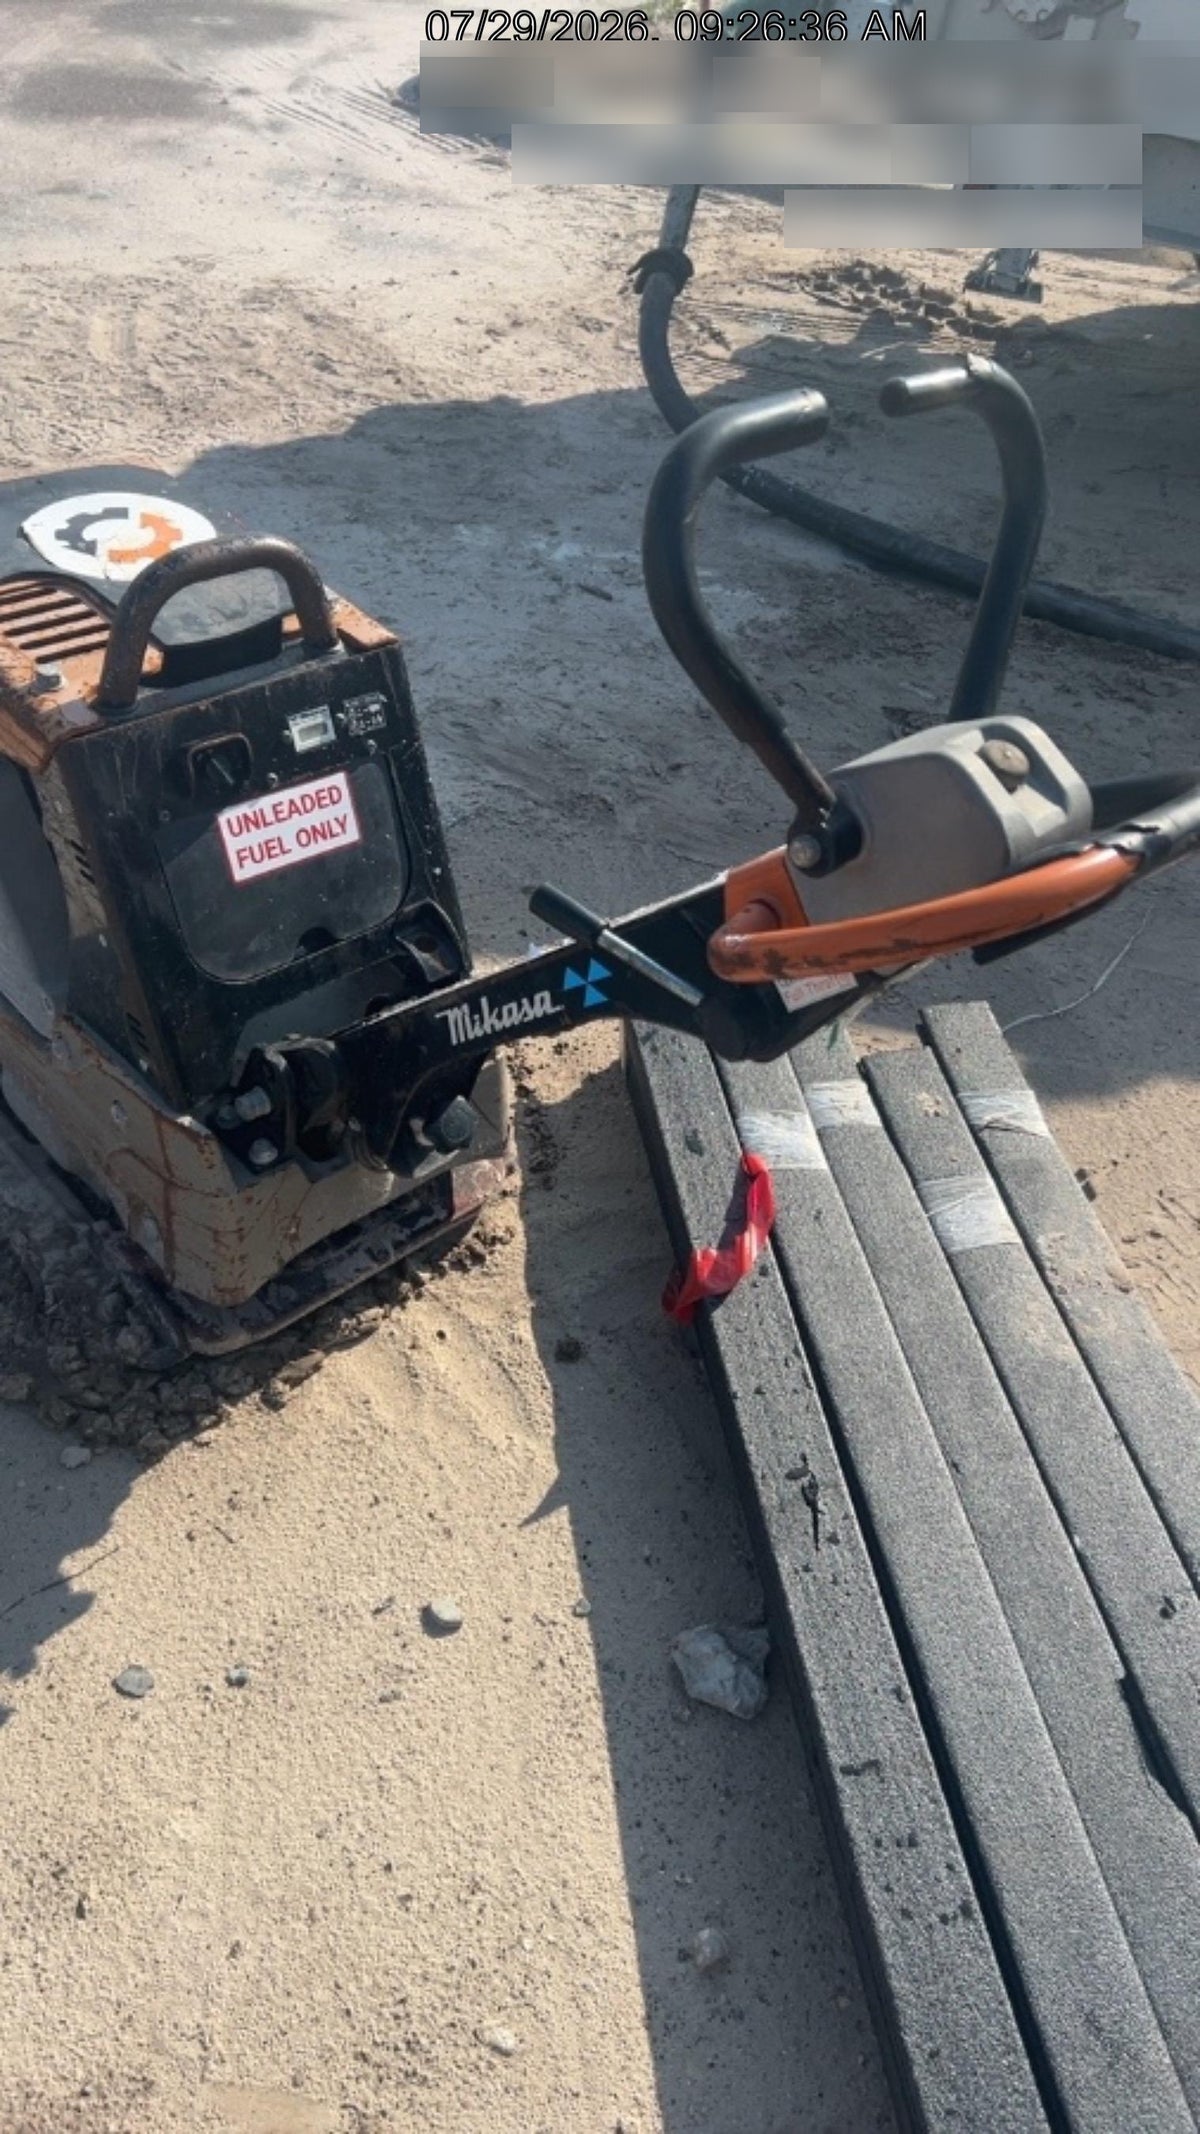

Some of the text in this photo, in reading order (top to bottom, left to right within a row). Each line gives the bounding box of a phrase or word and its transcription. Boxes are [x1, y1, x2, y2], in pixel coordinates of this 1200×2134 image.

[226, 785, 342, 837] UNLEADED
[236, 813, 348, 868] FUEL ONLY
[434, 990, 564, 1045] Mikasa
